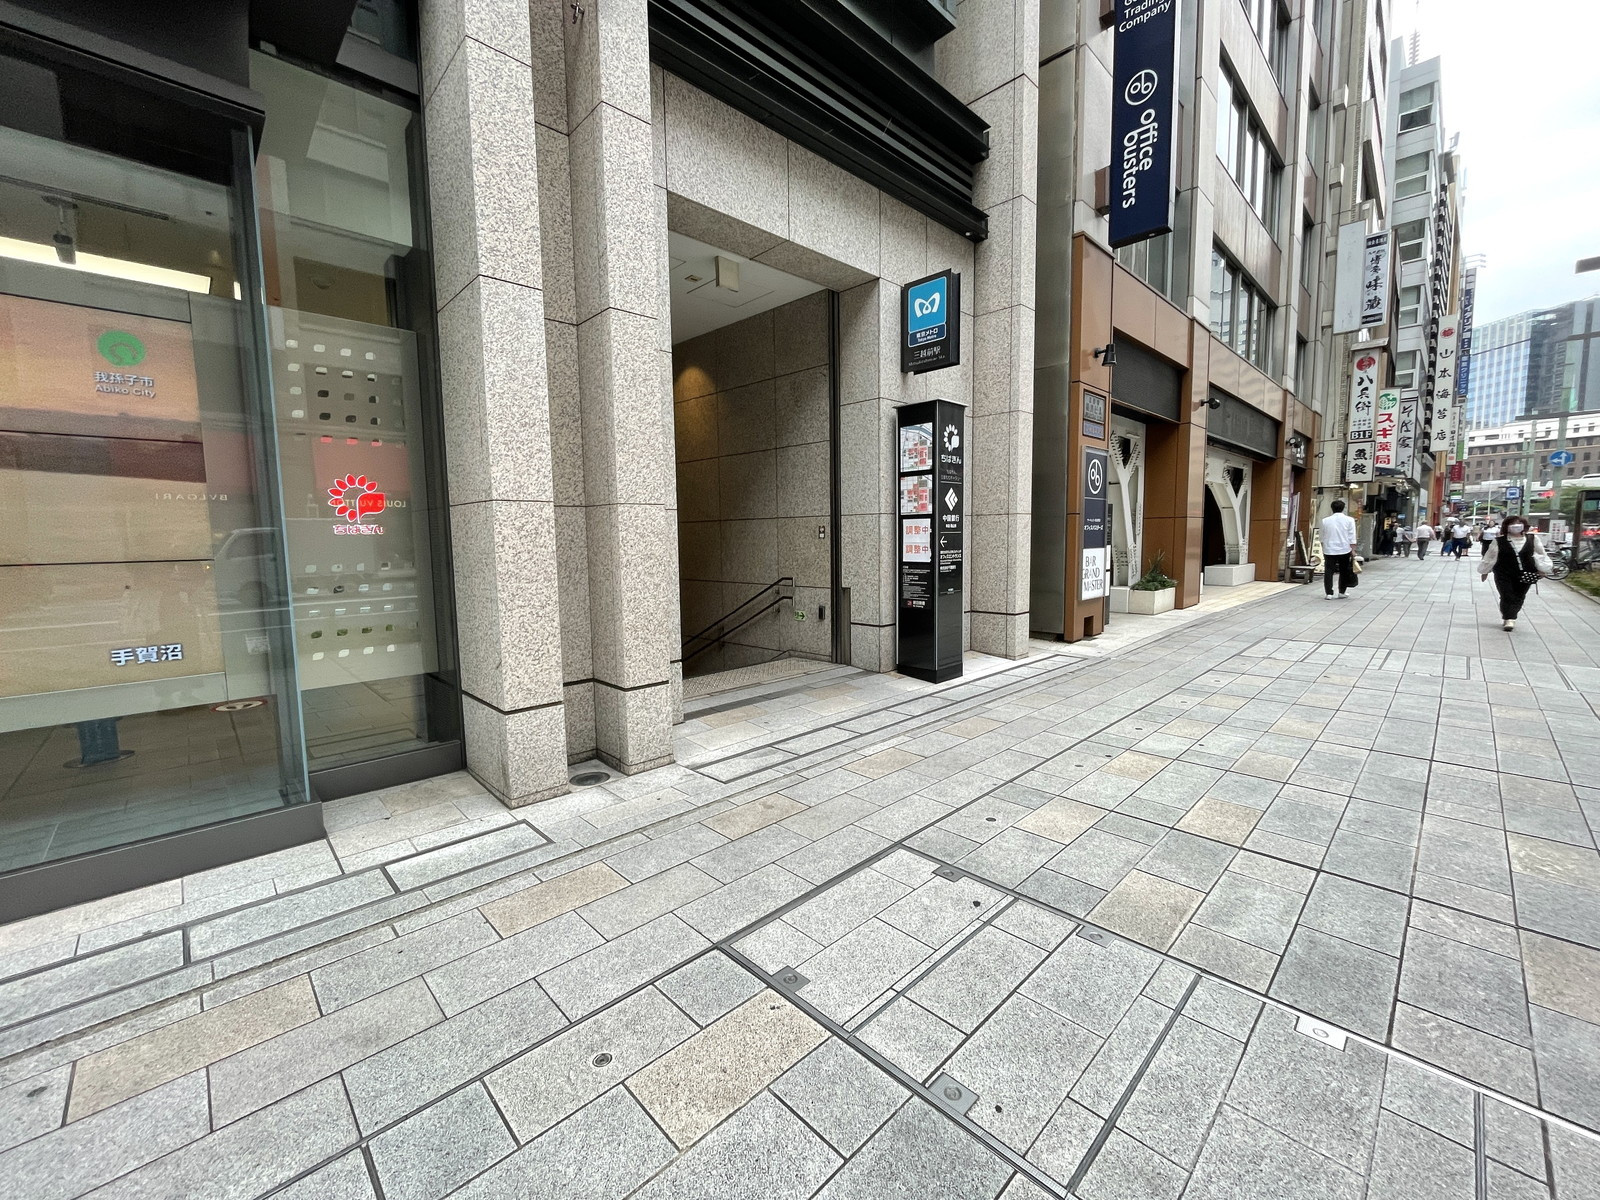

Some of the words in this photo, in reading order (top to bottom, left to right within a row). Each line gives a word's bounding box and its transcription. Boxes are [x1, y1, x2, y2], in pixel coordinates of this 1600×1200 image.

[1119, 0, 1171, 32] Company
[1139, 108, 1158, 171] office
[1122, 129, 1141, 209] busters
[916, 328, 938, 339] 東京メトロ
[914, 346, 941, 360] 三越前駅
[94, 371, 154, 387] 我孫子市
[95, 384, 130, 395] Abiko
[132, 388, 156, 398] City
[1434, 348, 1453, 440] 山本海苔店
[1351, 430, 1372, 440] B1F
[1375, 413, 1396, 465] スギ薬局
[940, 454, 962, 465] ちばぎん
[333, 524, 384, 535] ちばぎん
[905, 526, 929, 535] 調整中
[905, 544, 929, 554] 調整中
[1084, 579, 1104, 592] MASTER
[110, 643, 184, 667] 手賀沼
